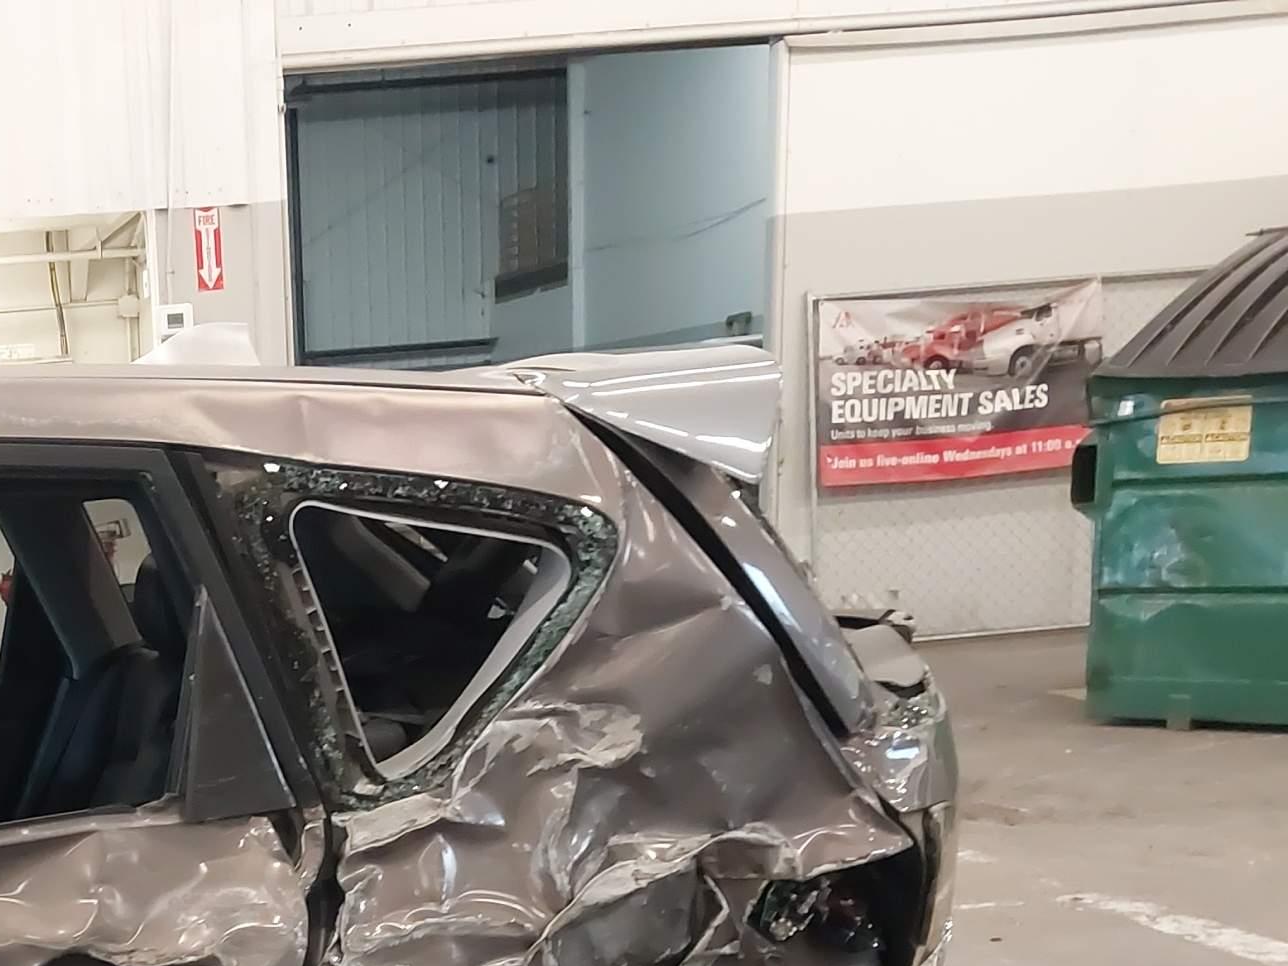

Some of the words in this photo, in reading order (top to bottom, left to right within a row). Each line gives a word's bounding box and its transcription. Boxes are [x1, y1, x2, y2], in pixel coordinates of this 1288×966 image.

[830, 369, 955, 396] SPECIALTY
[831, 391, 973, 424] EQUIPMENT
[977, 383, 1049, 415] SALES
[859, 458, 874, 467] us
[943, 446, 1013, 462] Wednesdays
[1015, 444, 1028, 455] at
